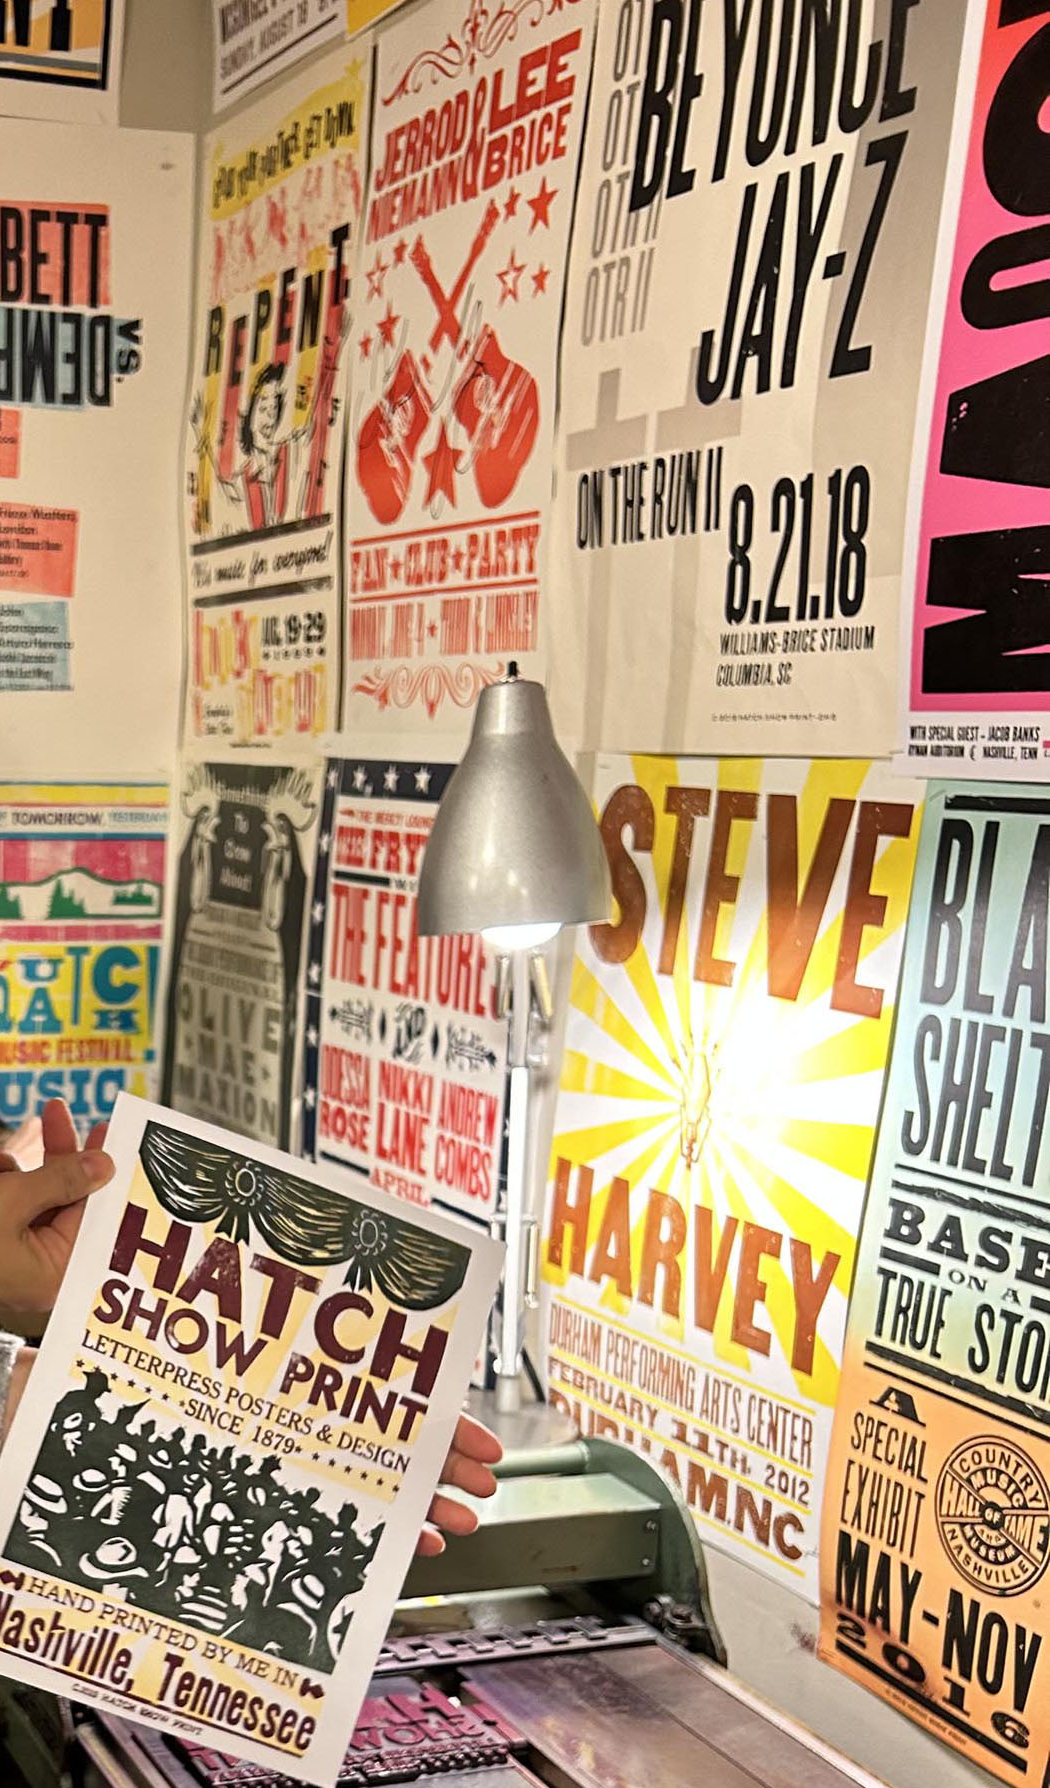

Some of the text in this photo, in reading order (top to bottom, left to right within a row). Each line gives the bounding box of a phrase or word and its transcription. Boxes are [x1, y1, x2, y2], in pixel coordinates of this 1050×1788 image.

[375, 89, 469, 192] JERROD
[461, 76, 487, 203] &
[488, 28, 583, 135] LEE
[366, 155, 462, 246] NIEMANN
[482, 102, 573, 191] BRICE
[203, 223, 351, 377] REPENT
[696, 130, 909, 406] JAY-Z
[577, 446, 724, 550] ON THE RUN II
[724, 464, 871, 626] 8.21.18
[350, 523, 541, 595] FAN CLUB PARTY
[719, 625, 876, 657] WILLIAMS-BRICE STADIUM
[776, 662, 794, 686] SC
[910, 726, 927, 741] WITH
[929, 726, 955, 741] SPECIAL
[956, 726, 980, 741] GUEST
[988, 726, 1011, 742] JACOB
[1012, 727, 1041, 742] BANKS
[11, 812, 103, 826] TOMORROW
[588, 784, 915, 1020] STEVE
[371, 891, 503, 1022] FEATURE
[56, 1037, 135, 1063] FESTIVAL
[377, 1059, 433, 1115] NIKKI
[319, 1100, 370, 1155] ROSE
[375, 1101, 430, 1178] LANE
[436, 1079, 499, 1150] ANDREW
[433, 1133, 493, 1205] COMBS
[108, 1202, 450, 1398] HATCH
[546, 1156, 841, 1377] HARVEY
[875, 1266, 953, 1360] TRUE
[948, 1268, 1022, 1307] ON A
[81, 1335, 411, 1475] LETTERPRESS POSTERS & DESIGN
[93, 1278, 429, 1443] SHOW PRINT
[549, 1302, 814, 1470] DURHAM PERFORMING ARTS CENTER
[869, 1386, 927, 1427] A
[184, 1398, 296, 1454] SINCE 1879
[548, 1356, 660, 1430] FEBRUARY
[765, 1464, 810, 1506] 2012
[850, 1412, 929, 1483] SPECIAL
[840, 1458, 926, 1559] EXHIBIT
[940, 1470, 1050, 1566] HALL OF FAME
[958, 1447, 1043, 1504] COUNTRY
[969, 1468, 1025, 1508] MUSIC
[946, 1527, 1029, 1584] NASHVILLE
[962, 1523, 1018, 1562] MUSEUM
[24, 1575, 302, 1689] HAND PRINTED BY ME IN
[155, 1652, 318, 1752] Tennessee
[835, 1612, 1031, 1750] 2016
